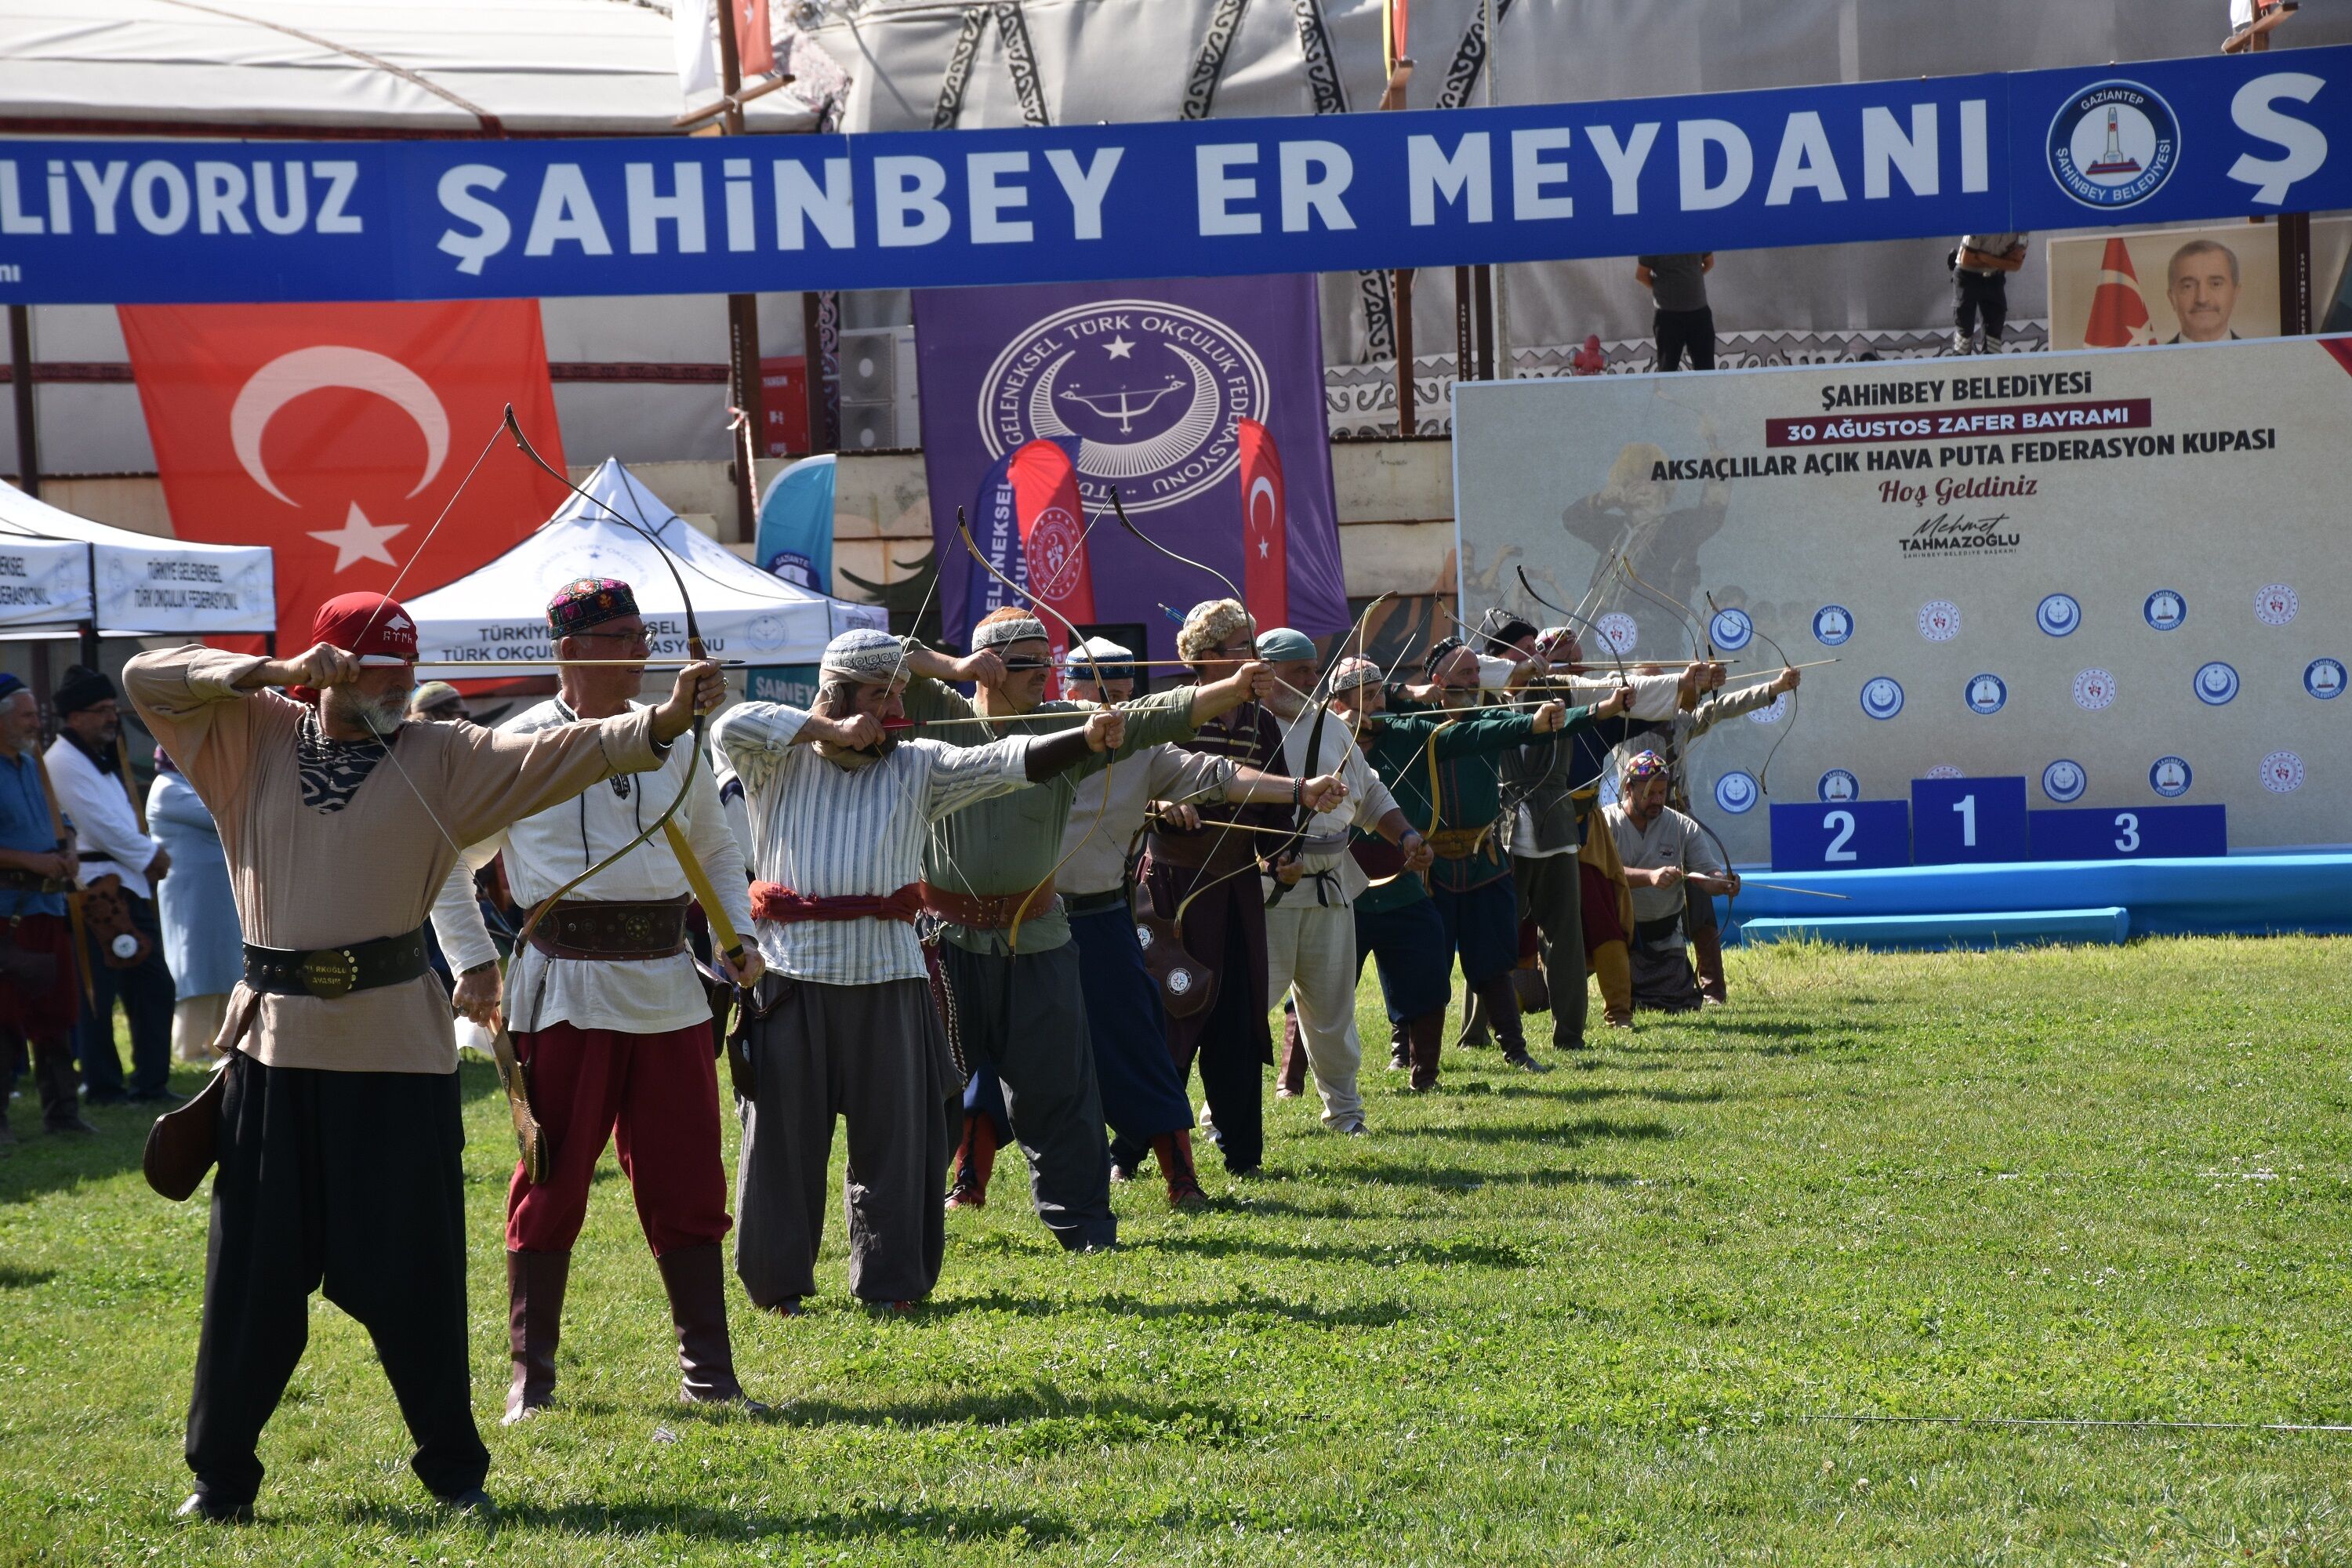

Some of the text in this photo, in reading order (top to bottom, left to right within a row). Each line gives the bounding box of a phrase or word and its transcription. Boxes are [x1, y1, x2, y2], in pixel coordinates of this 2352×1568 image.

[2080, 89, 2145, 111] GAZİANTEP
[437, 100, 1989, 276] ŞAHİNBEY ER MEYDANI
[2056, 139, 2171, 201] ŞAHİNBEY BELEDİYESİ
[0, 160, 363, 235] LİYORUZ
[1000, 315, 1249, 495] GELENEKSEL TÜRK OKÇULUK FEDERASYONU
[1821, 371, 2092, 411] ŞAHİNBEY BELEDİYESİ
[1788, 407, 2129, 441] 30 AĞUSTOS ZAFER BAYRAMI
[1650, 428, 2275, 482] AKSAÇLILAR AÇIK HAVA PUTA FEDERASYON KUPASI
[1878, 474, 2038, 507] Hoş Geldiniz
[775, 554, 811, 567] GAZİANTE
[985, 481, 1012, 612] ELENEKSEL
[1898, 532, 2020, 551] TAHMAZOĞLU
[441, 644, 554, 662] TÜRK OKÇUL
[1823, 810, 1857, 862] 2
[1952, 794, 1976, 847] 1
[2114, 813, 2140, 852] 3
